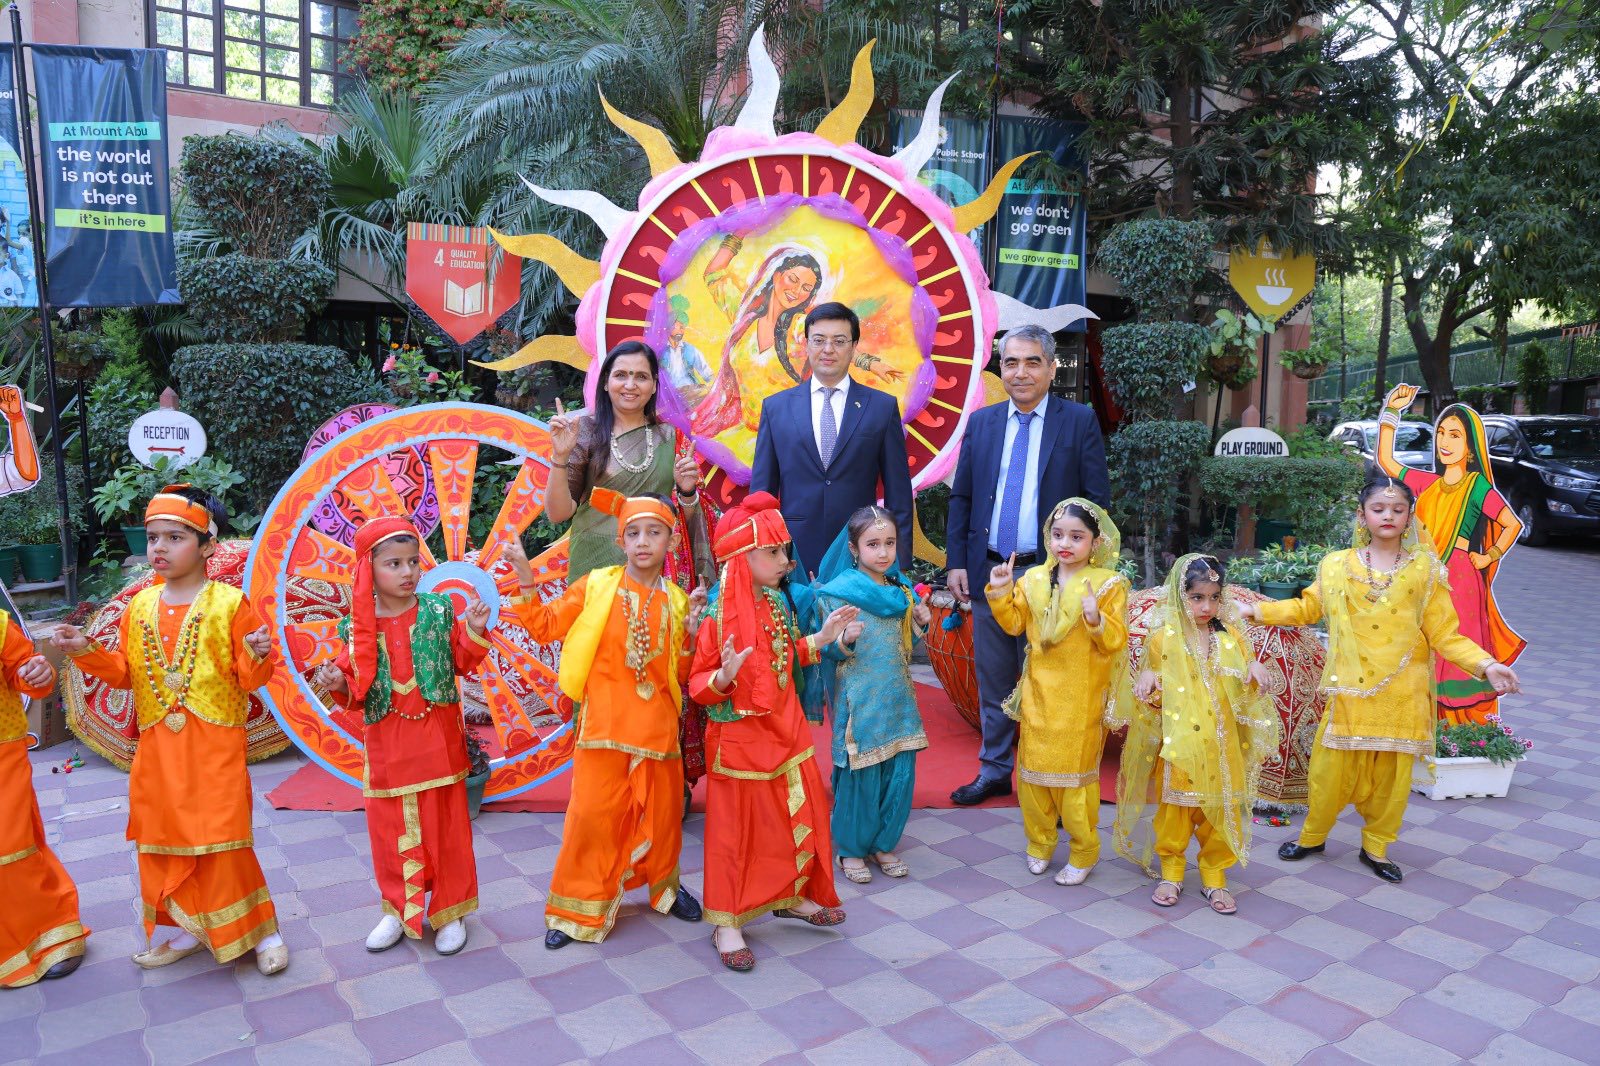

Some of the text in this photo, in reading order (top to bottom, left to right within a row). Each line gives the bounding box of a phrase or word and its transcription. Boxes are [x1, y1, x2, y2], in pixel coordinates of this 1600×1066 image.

[62, 126, 148, 137] At Mount Abu
[57, 147, 151, 165] the world
[936, 148, 986, 160] Public School
[62, 167, 153, 185] is not out
[1011, 181, 1022, 191] At
[82, 189, 137, 205] there
[1011, 204, 1070, 219] we don't
[79, 213, 146, 228] it's in here
[1010, 223, 1072, 237] go green
[433, 248, 477, 267] 4 QUALITY
[1004, 252, 1076, 266] we grow green.
[450, 260, 485, 270] EDUCATION
[143, 425, 190, 440] RECEPTION
[1221, 441, 1283, 455] PLAY GROUND
